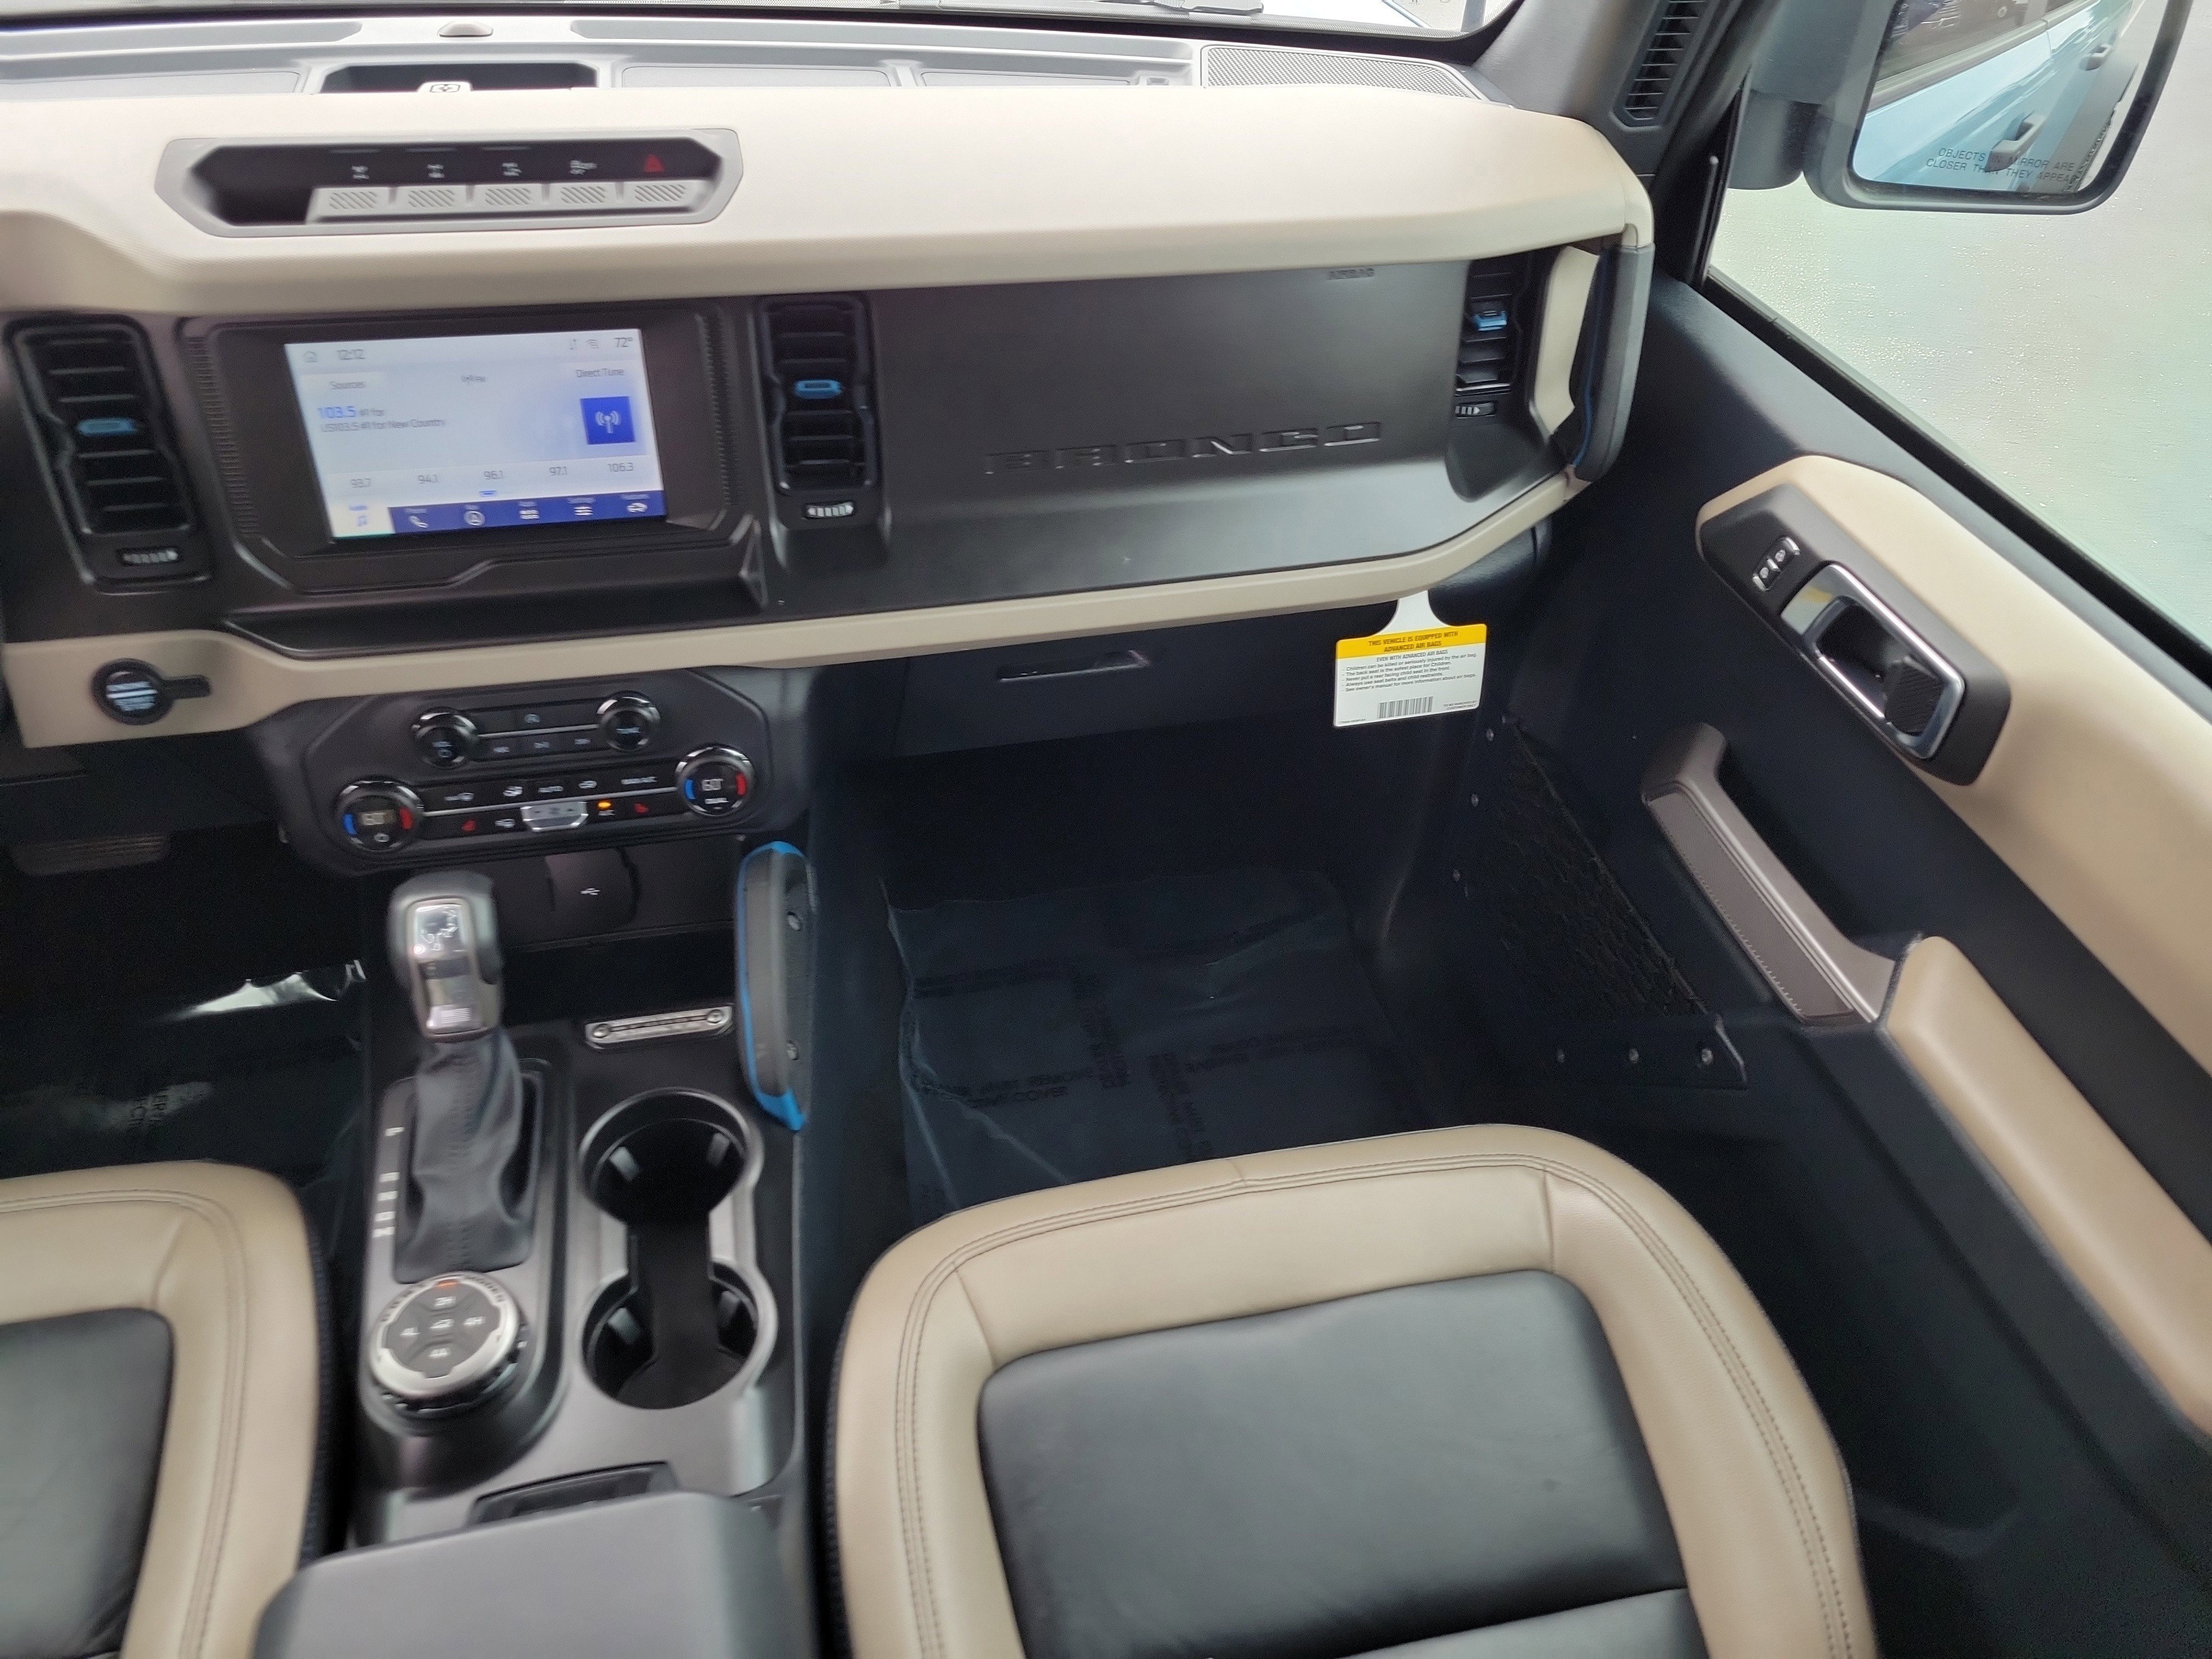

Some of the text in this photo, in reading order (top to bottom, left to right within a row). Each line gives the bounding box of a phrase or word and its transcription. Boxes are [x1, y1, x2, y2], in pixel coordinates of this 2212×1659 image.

[1938, 148, 1986, 161] OBJECTS
[2054, 162, 2075, 171] ARE
[1927, 158, 1967, 171] CLOSER
[2006, 168, 2033, 178] THEY
[575, 368, 625, 378] Direct Tune
[318, 405, 357, 419] 103.5
[387, 420, 408, 429] New
[986, 421, 1381, 475] BRONCO
[1384, 644, 1414, 652] ADVANCED
